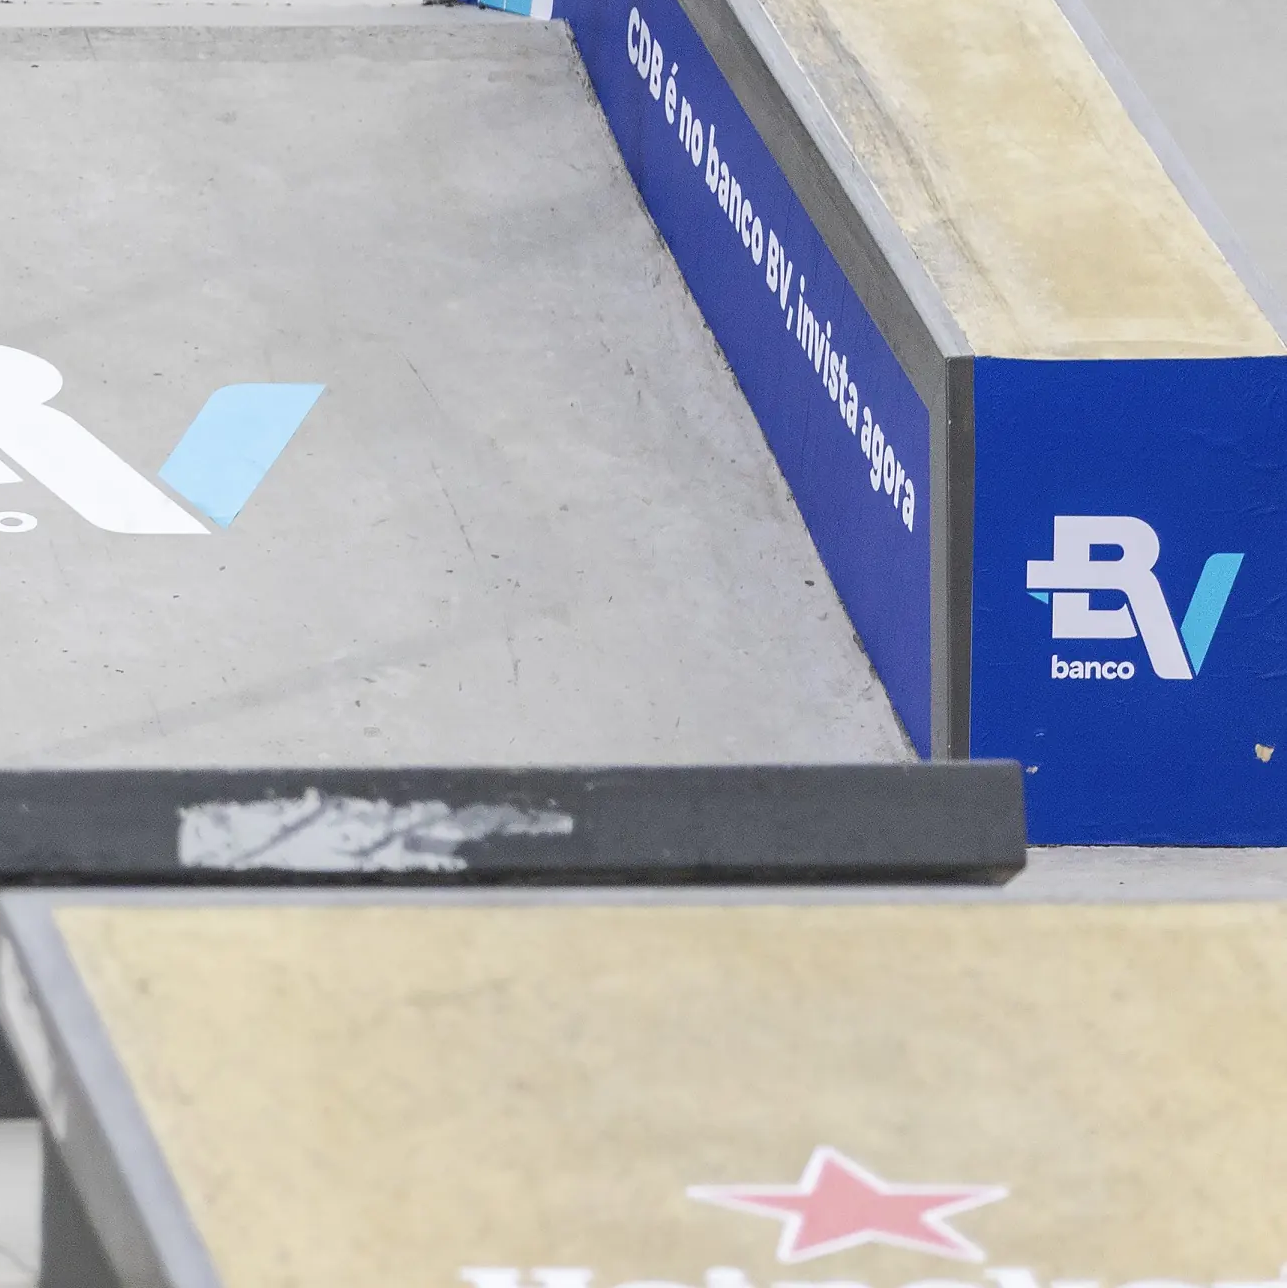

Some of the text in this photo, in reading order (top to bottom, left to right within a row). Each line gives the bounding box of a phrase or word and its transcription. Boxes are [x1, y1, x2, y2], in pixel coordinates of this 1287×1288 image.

[627, 6, 915, 533] CDB é no banco BV, invista agora
[1027, 516, 1245, 679] BV
[1051, 655, 1135, 680] banco
